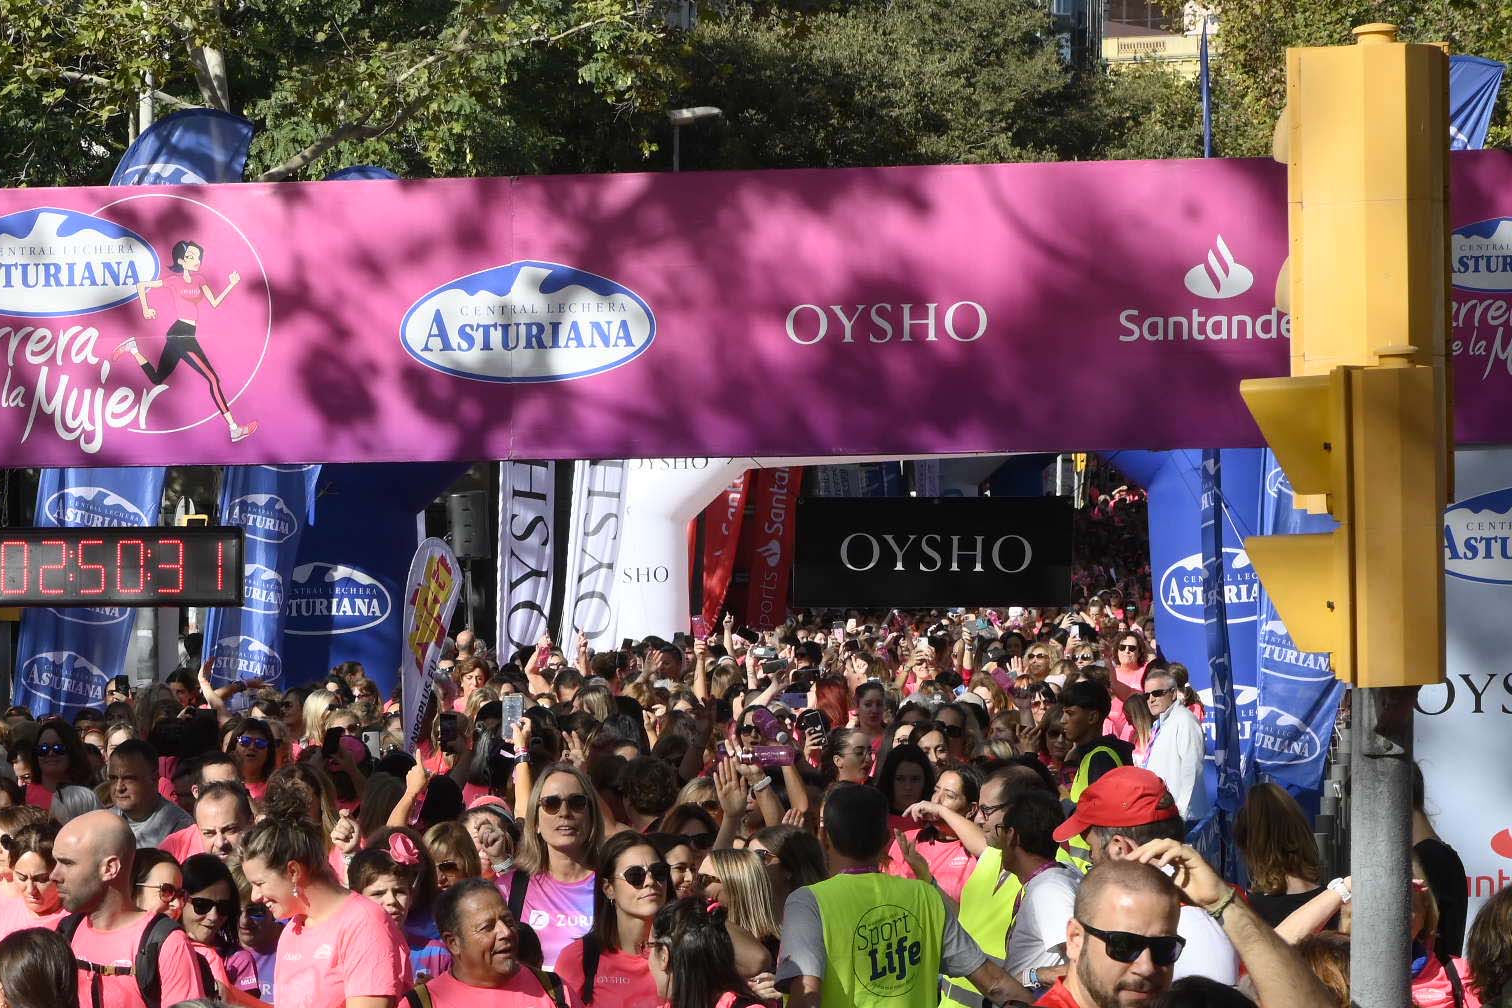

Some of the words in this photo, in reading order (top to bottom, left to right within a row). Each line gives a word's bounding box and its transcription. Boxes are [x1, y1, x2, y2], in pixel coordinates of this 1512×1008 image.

[62, 244, 135, 255] LECHERA
[459, 303, 539, 316] CENTRAL
[547, 301, 628, 314] LECHERA
[786, 300, 989, 346] OYSHO
[1118, 308, 1291, 343] Santande
[422, 308, 635, 353] ASTURIANA
[0, 366, 26, 409] la
[21, 358, 170, 455] Mujer
[764, 467, 790, 536] Santa
[0, 539, 224, 595] 02:50:31
[507, 461, 550, 648] OYSH
[573, 461, 622, 639] OYSH
[839, 533, 1033, 574] OYSHO
[622, 566, 670, 583] SHO
[759, 571, 778, 630] ports
[215, 656, 276, 677] STURIANA
[1262, 643, 1331, 673] TURIAN
[555, 913, 594, 929] ZURI
[857, 912, 911, 951] Sport
[868, 935, 921, 981] Life
[598, 976, 632, 985] OYSHO
